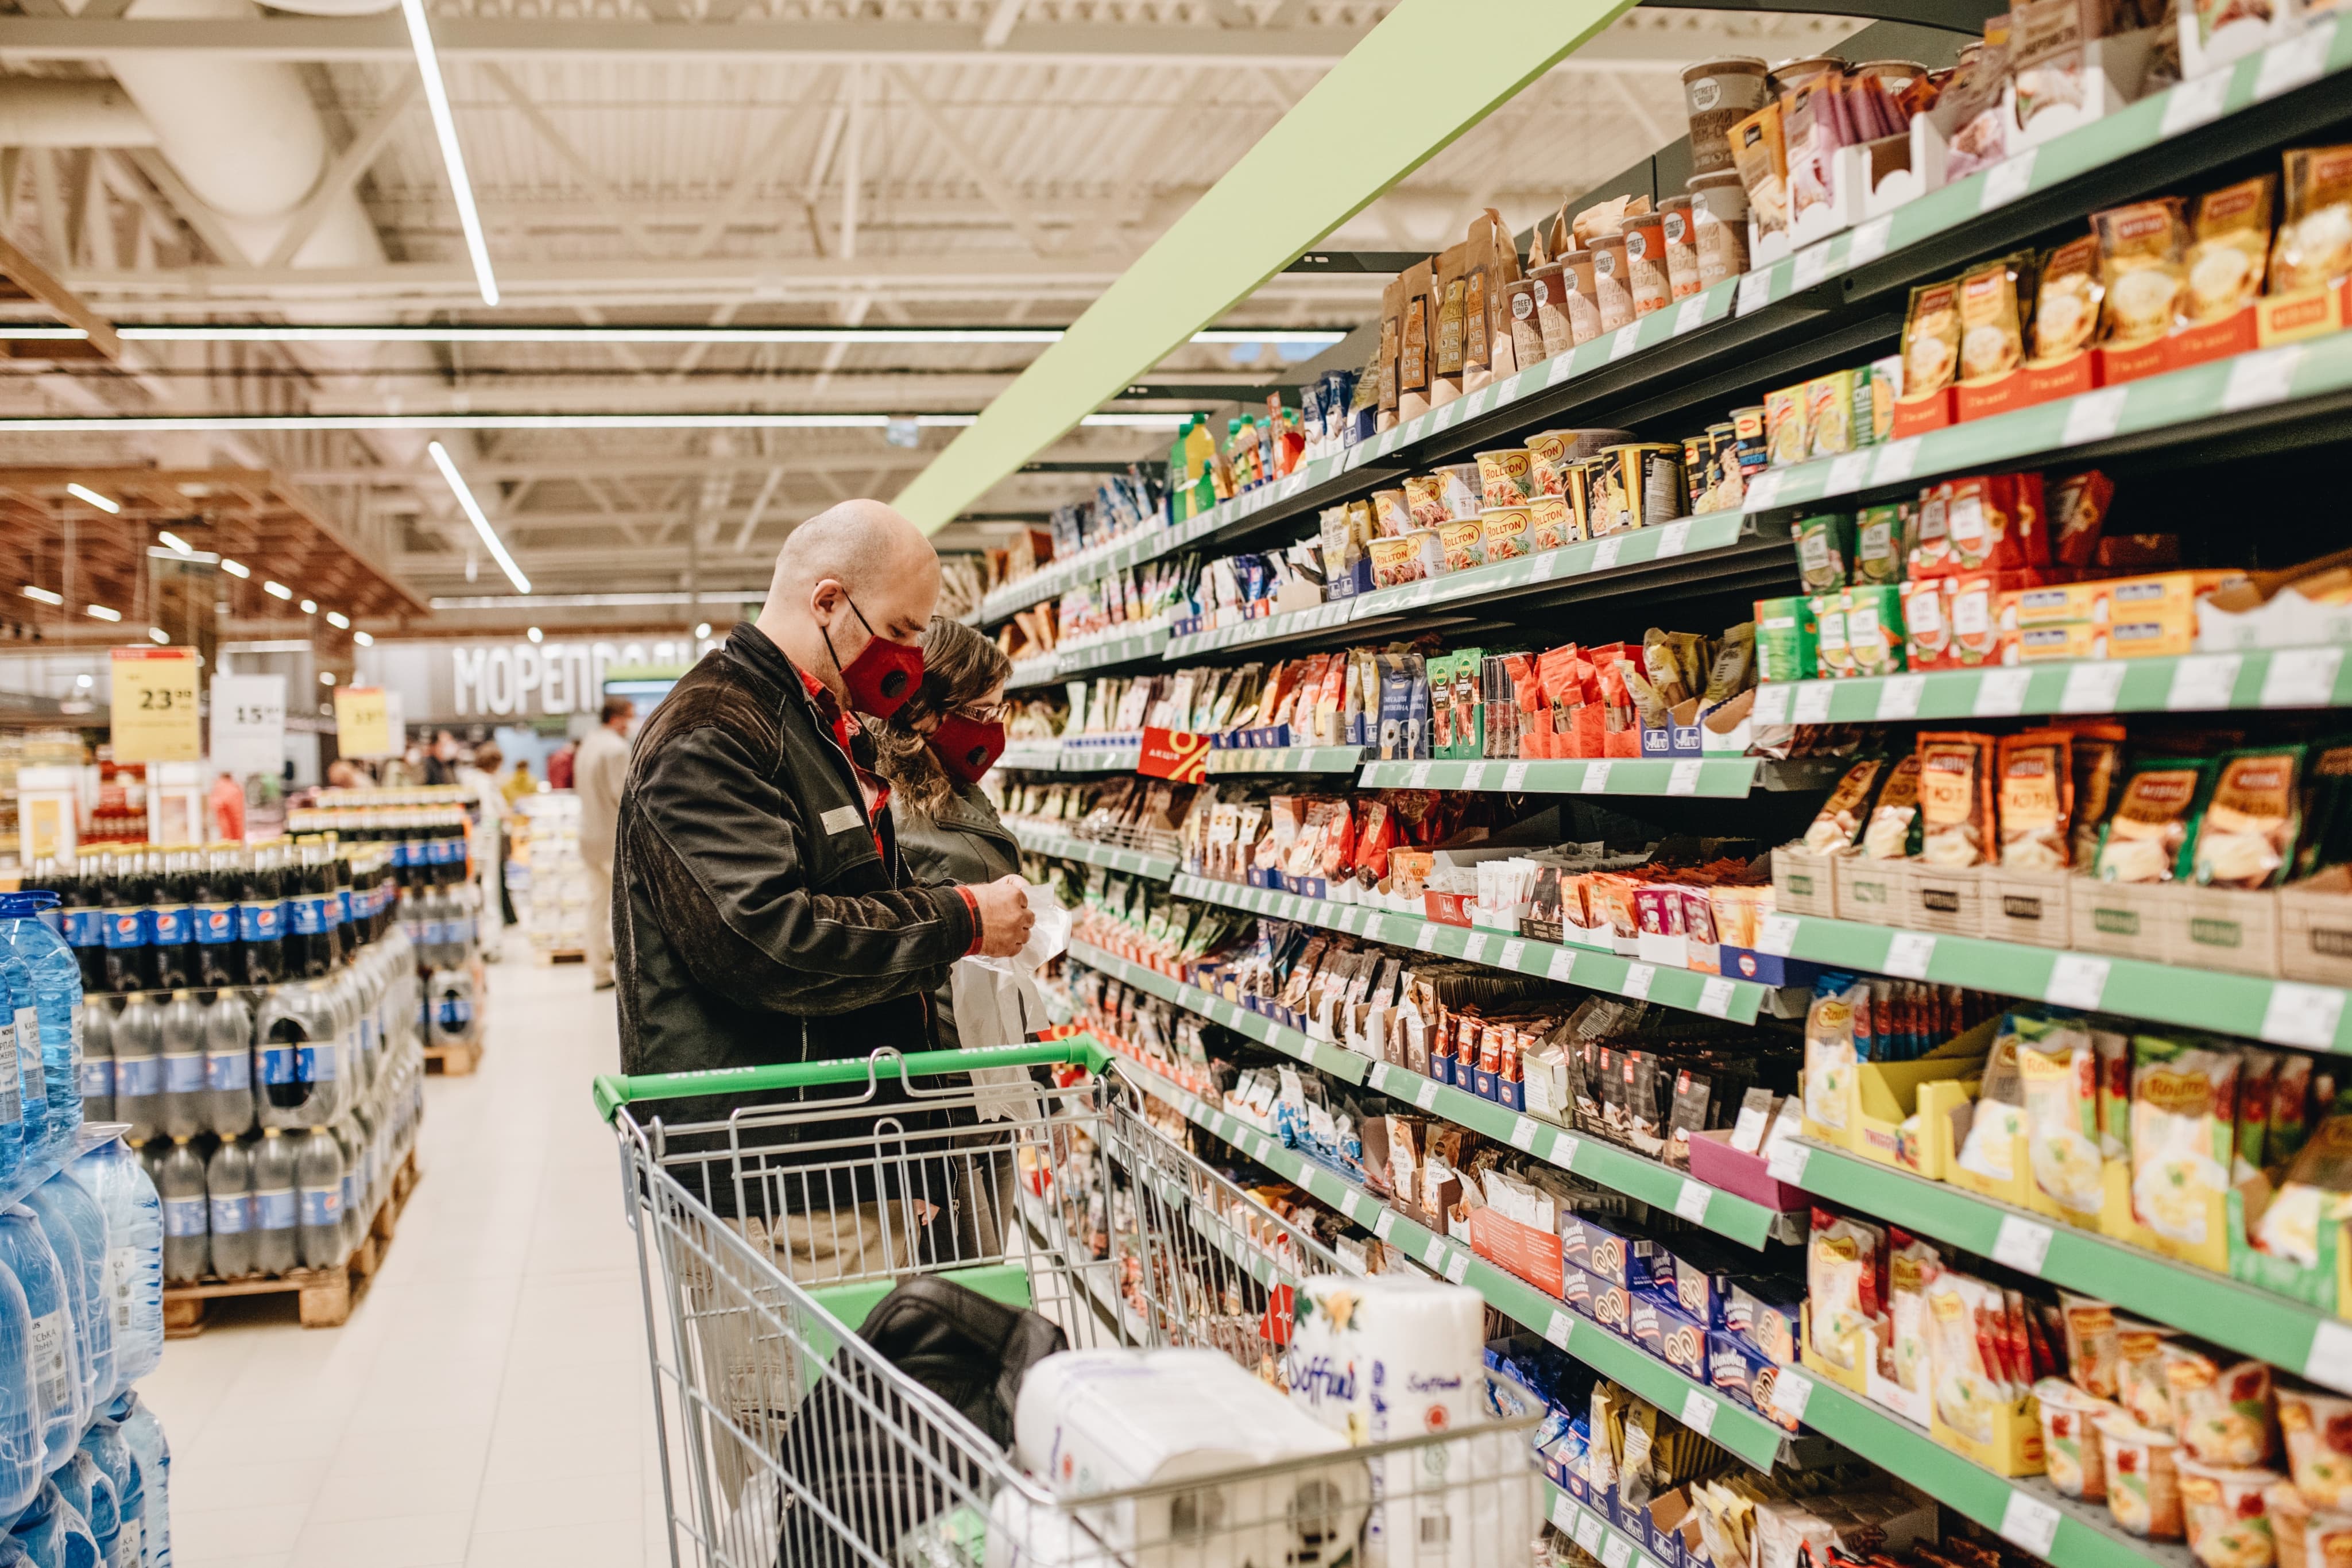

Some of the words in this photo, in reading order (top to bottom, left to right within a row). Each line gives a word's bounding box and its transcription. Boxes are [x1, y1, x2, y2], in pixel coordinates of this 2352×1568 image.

[1513, 298, 1531, 309] STREET
[1515, 307, 1529, 316] SOUP
[1485, 462, 1523, 481] ROLLTON
[1409, 488, 1436, 505] ROLLTON
[1487, 521, 1521, 539] ROLLTON
[1443, 532, 1475, 548] ROLLTON
[1376, 550, 1407, 565] ROLLTON
[139, 688, 172, 710] 23
